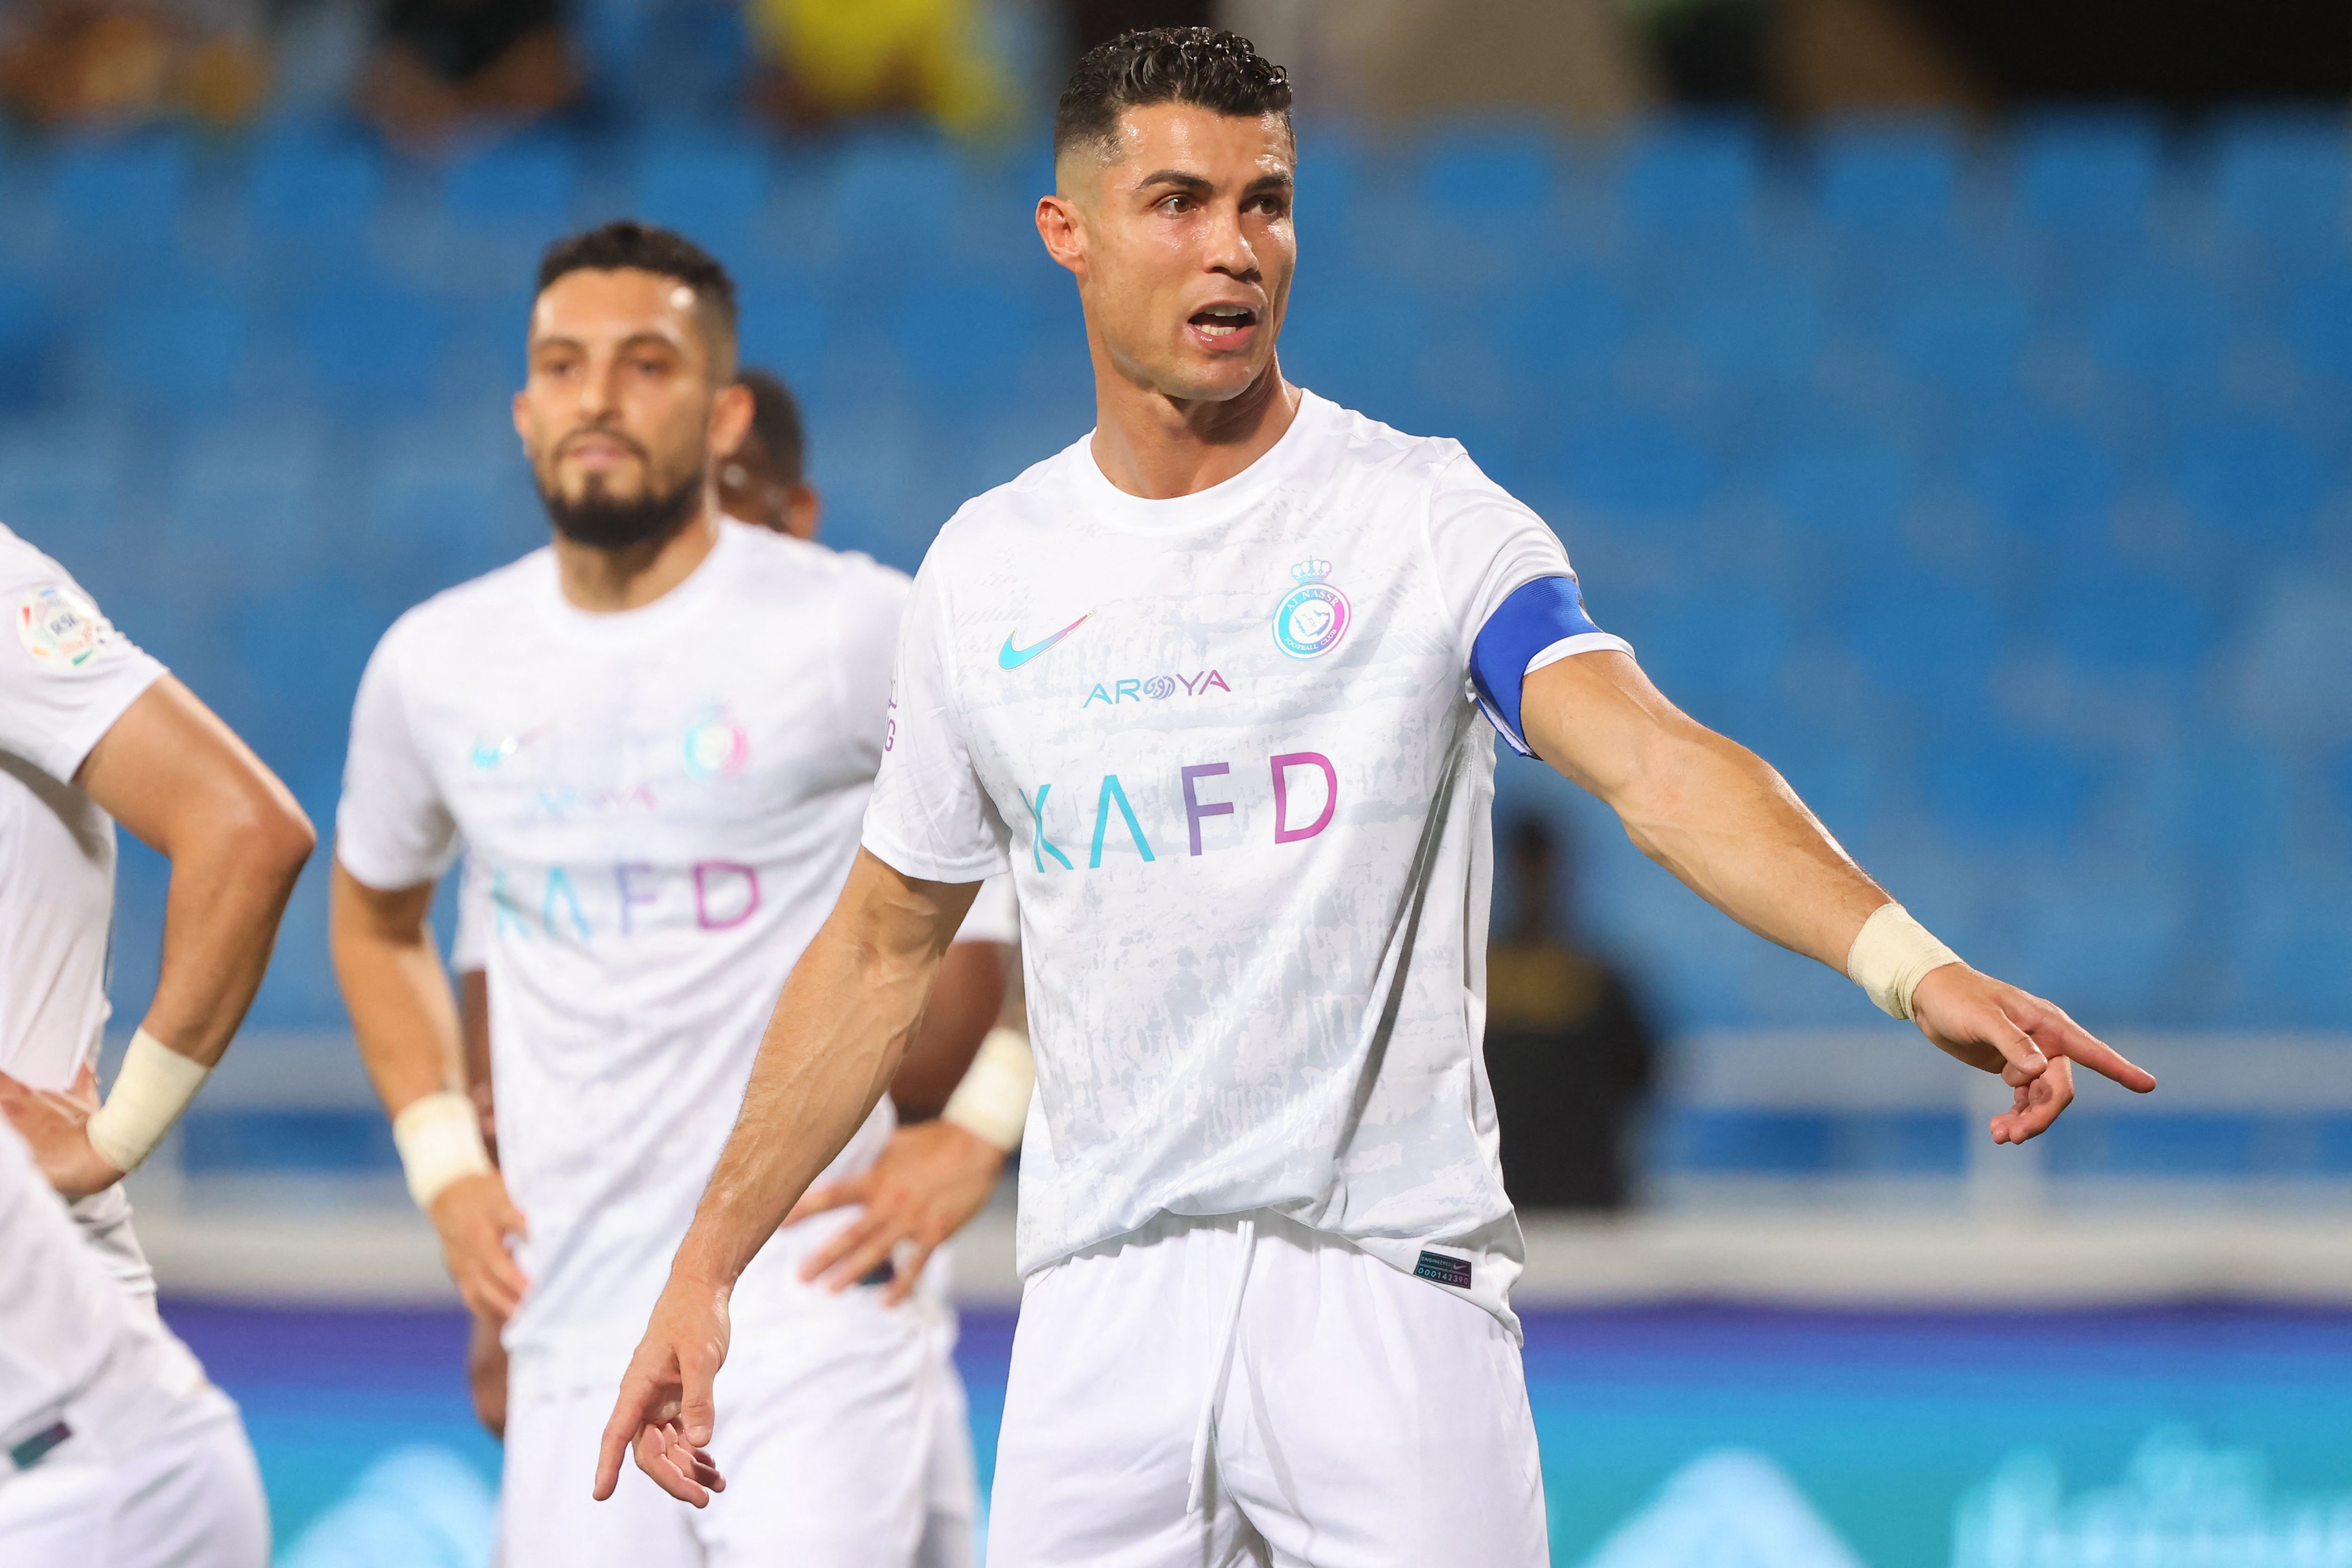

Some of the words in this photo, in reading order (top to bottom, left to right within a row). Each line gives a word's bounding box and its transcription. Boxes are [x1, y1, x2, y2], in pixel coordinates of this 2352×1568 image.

[1286, 598, 1301, 612] AL
[1302, 590, 1339, 607] NASSR
[1284, 637, 1318, 651] FOOTBALL
[1320, 629, 1337, 646] CLUB
[1018, 751, 1337, 873] KAFD
[1418, 1268, 1469, 1285] 000142390
